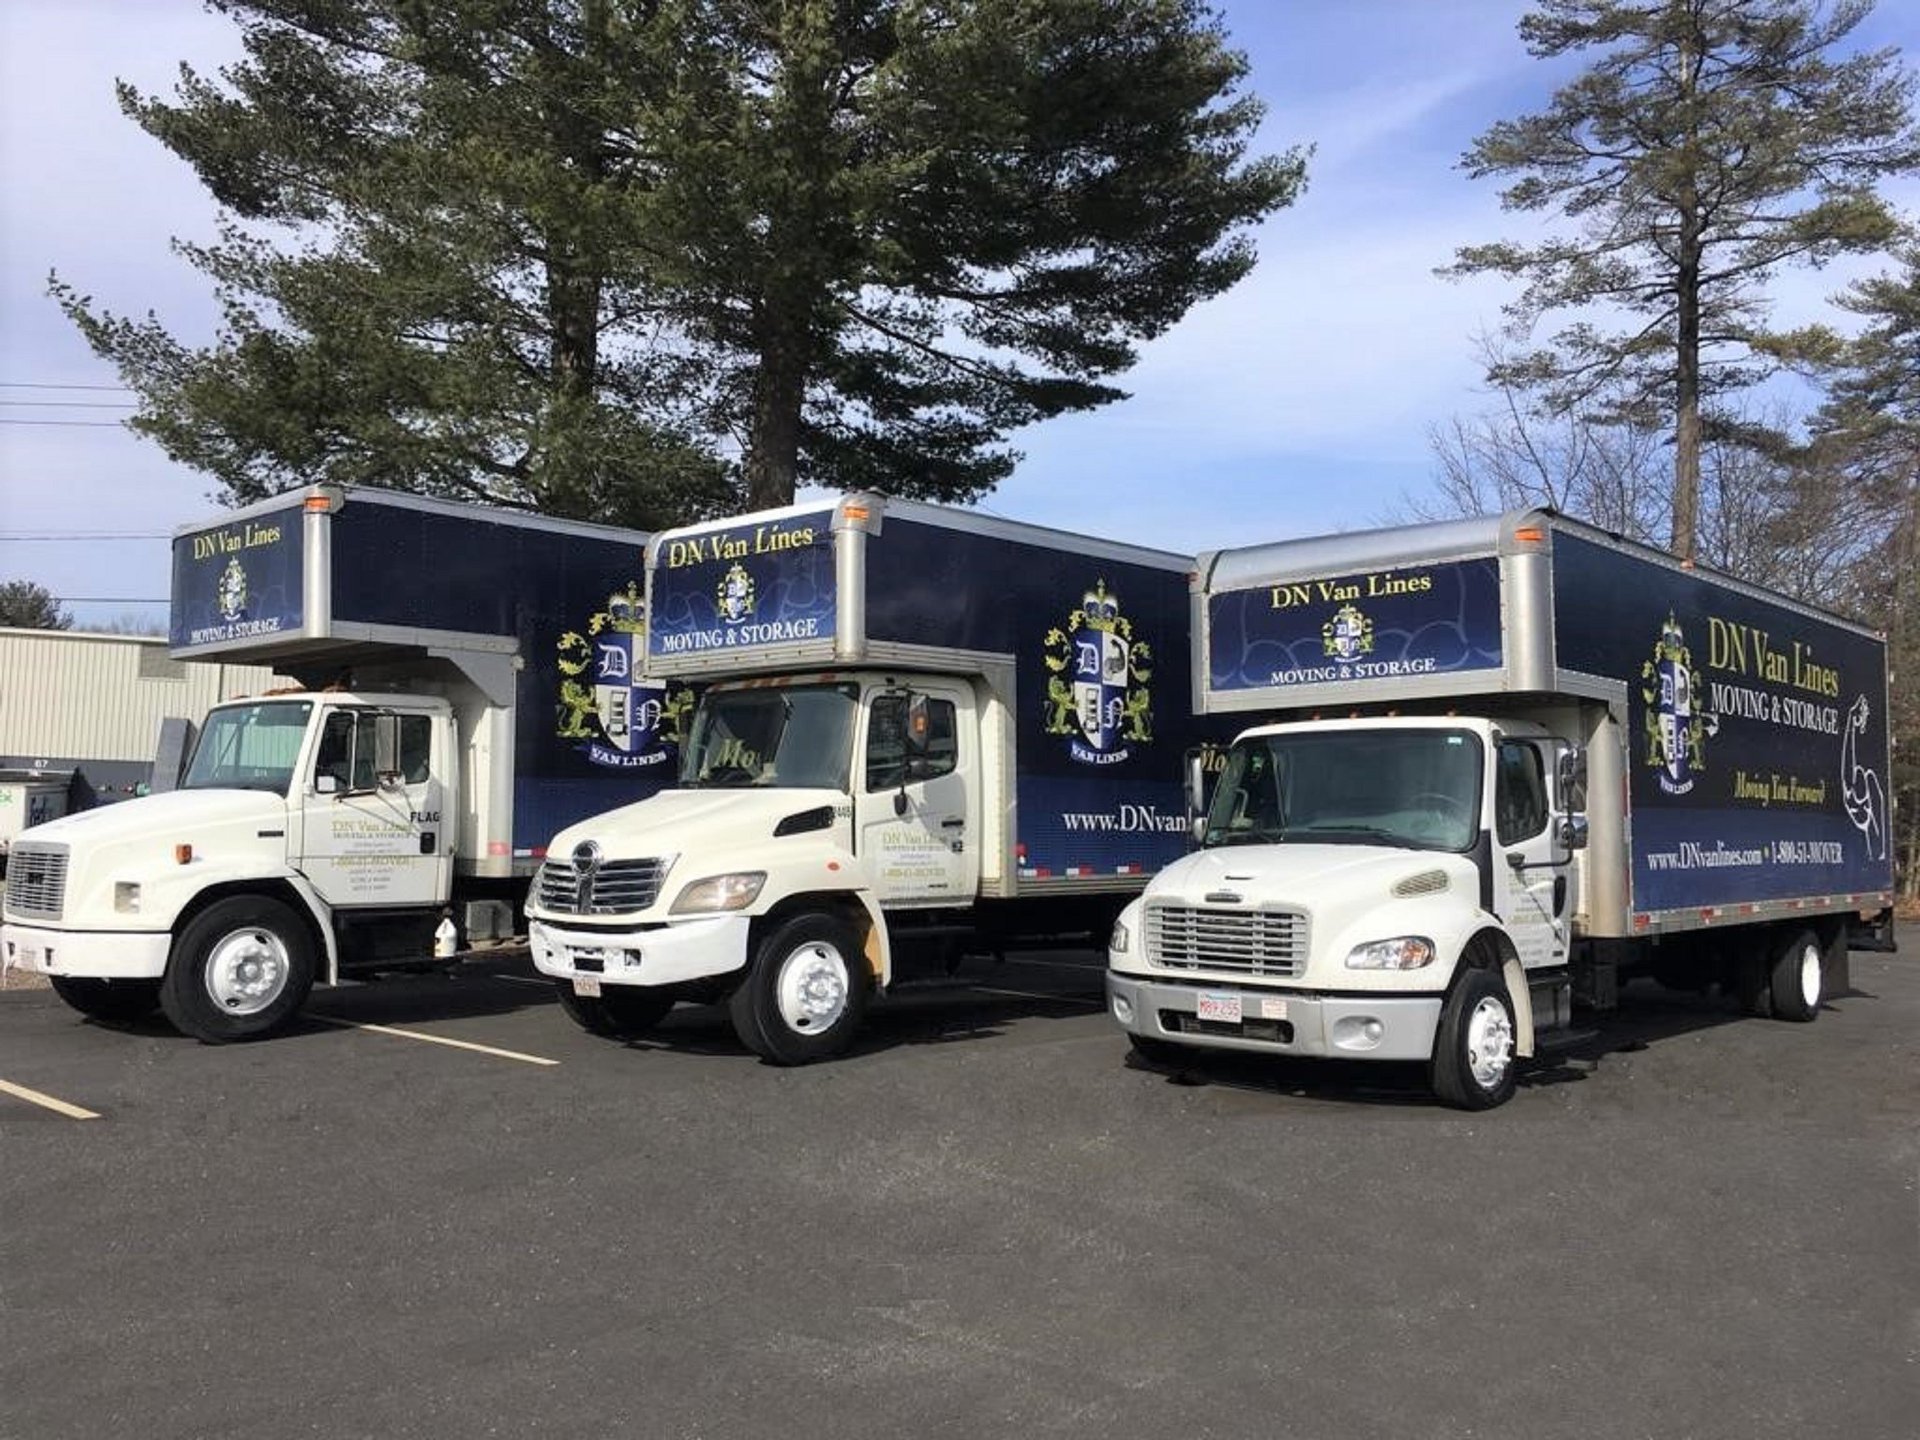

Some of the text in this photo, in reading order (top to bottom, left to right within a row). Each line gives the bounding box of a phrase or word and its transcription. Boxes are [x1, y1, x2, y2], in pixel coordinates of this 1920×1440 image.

[194, 524, 280, 559] DN Van Lines
[669, 525, 813, 569] DN Van Lines
[1271, 573, 1432, 609] DN Van Lines
[191, 624, 226, 644] MOVING
[235, 617, 281, 638] STORAGE
[663, 618, 819, 652] MOVING & STORAGE
[1271, 657, 1436, 686] MOVING & STORAGE
[1708, 616, 1840, 698] DN Van Lines
[1709, 682, 1840, 735] MOVING & STORAGE
[590, 746, 667, 767] VAN LINES
[410, 811, 440, 822] FLAG
[1647, 840, 1763, 871] www.DNvanlines.com
